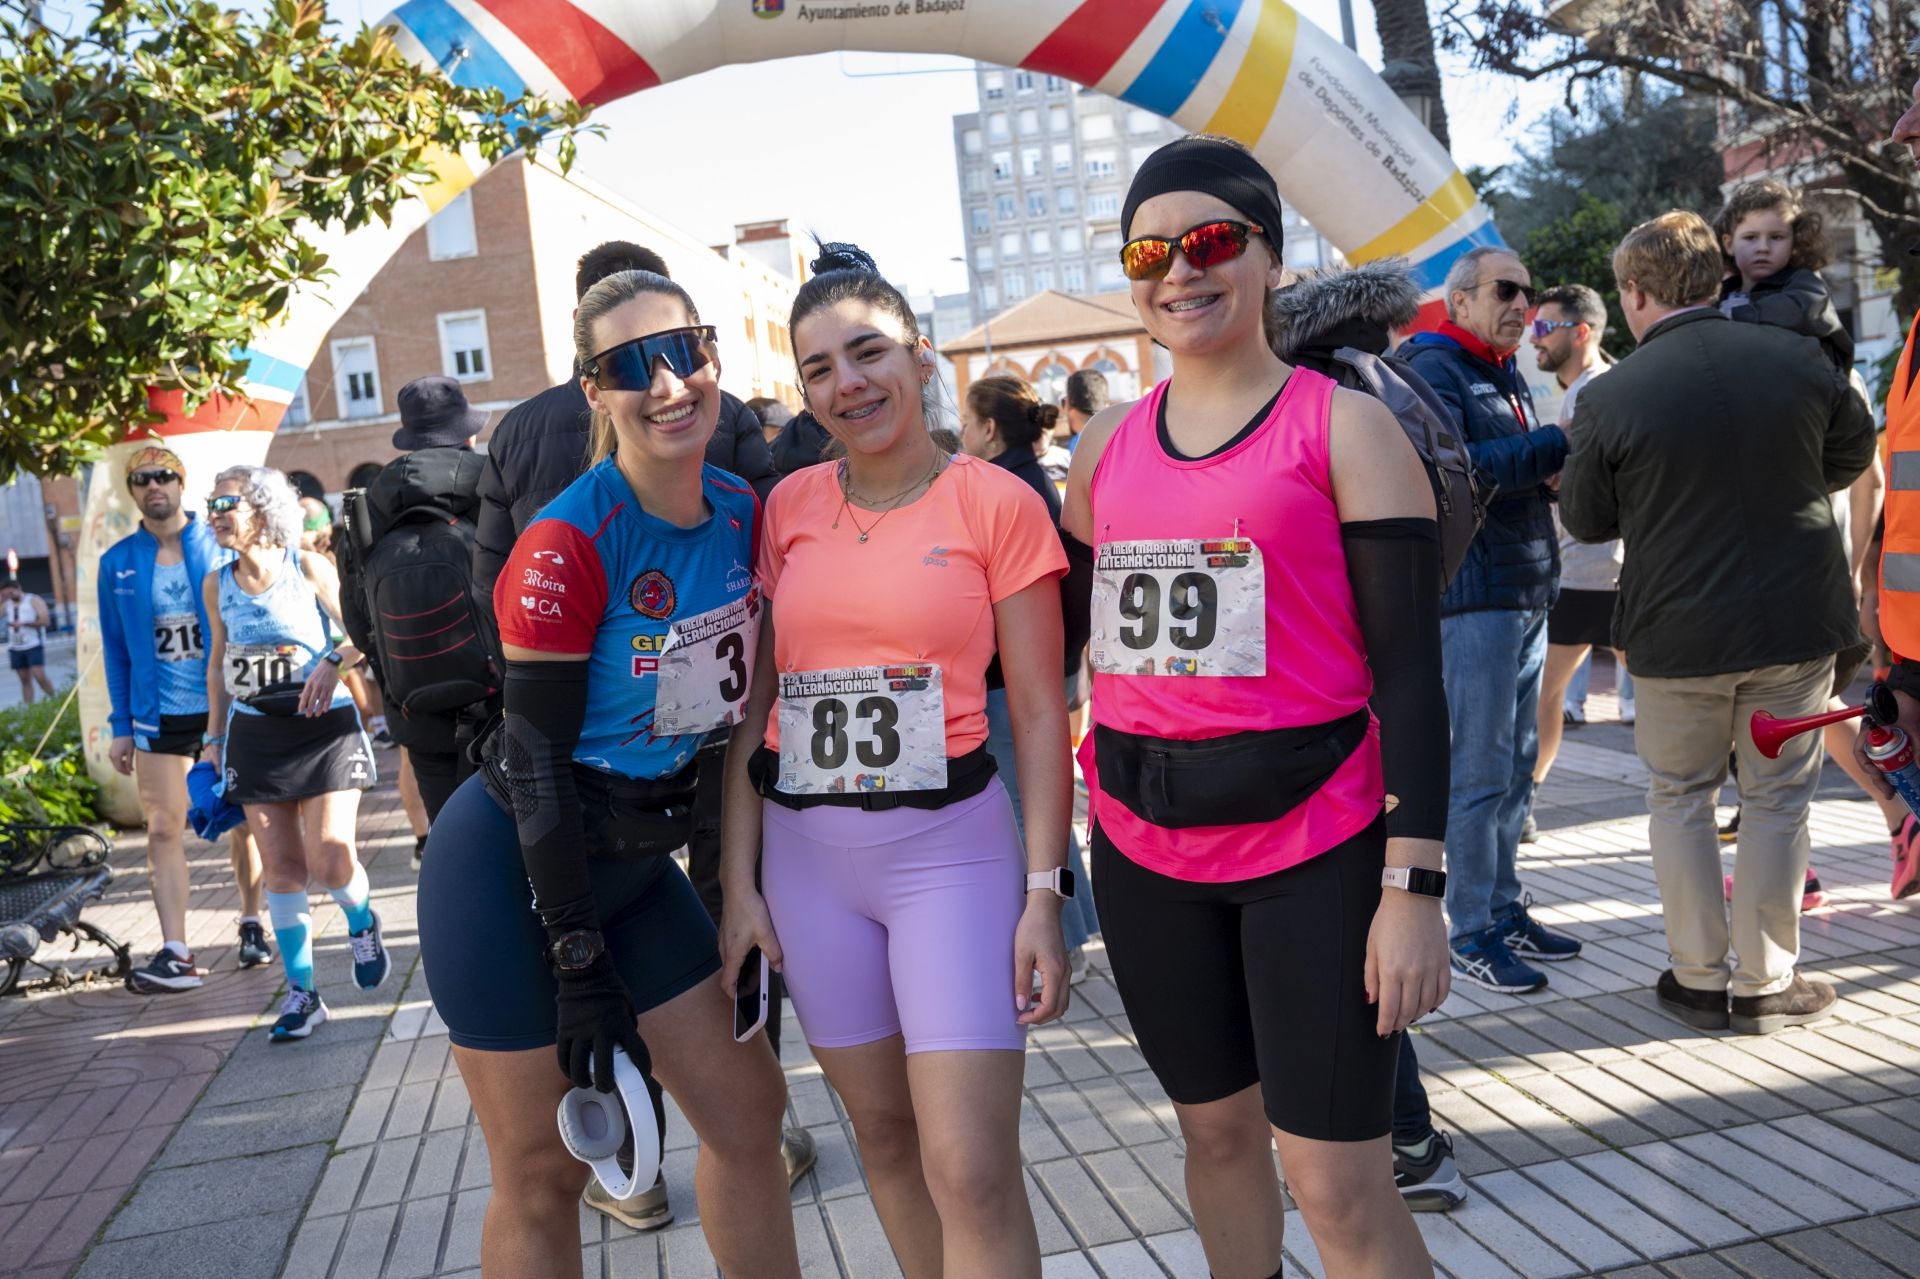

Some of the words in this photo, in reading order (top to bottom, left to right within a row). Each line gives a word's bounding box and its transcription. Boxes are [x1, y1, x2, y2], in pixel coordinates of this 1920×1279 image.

[797, 3, 890, 22] Ayuntamiento
[894, 3, 910, 15] de
[915, 0, 965, 15] Badajoz
[1310, 56, 1364, 113] Fundación
[1364, 112, 1416, 167] Municipal
[1298, 71, 1315, 89] de
[1315, 86, 1364, 141] Deportes
[1365, 140, 1382, 158] de
[1382, 155, 1427, 203] Badajoz
[1099, 554, 1195, 569] INTERNACIONAL
[1113, 544, 1133, 555] MEIA
[1136, 543, 1195, 554] MARATONA
[523, 568, 566, 593] Moira
[538, 599, 562, 617] CA
[1119, 572, 1217, 650] 99
[672, 611, 746, 651] TERNACIONAL
[681, 616, 705, 633] MEIA
[232, 657, 292, 688] 210
[716, 632, 747, 703] 3
[802, 674, 824, 684] MEIA
[826, 669, 879, 681] MARATONA
[786, 679, 878, 697] INTERNACIONAL
[811, 696, 900, 769] 83
